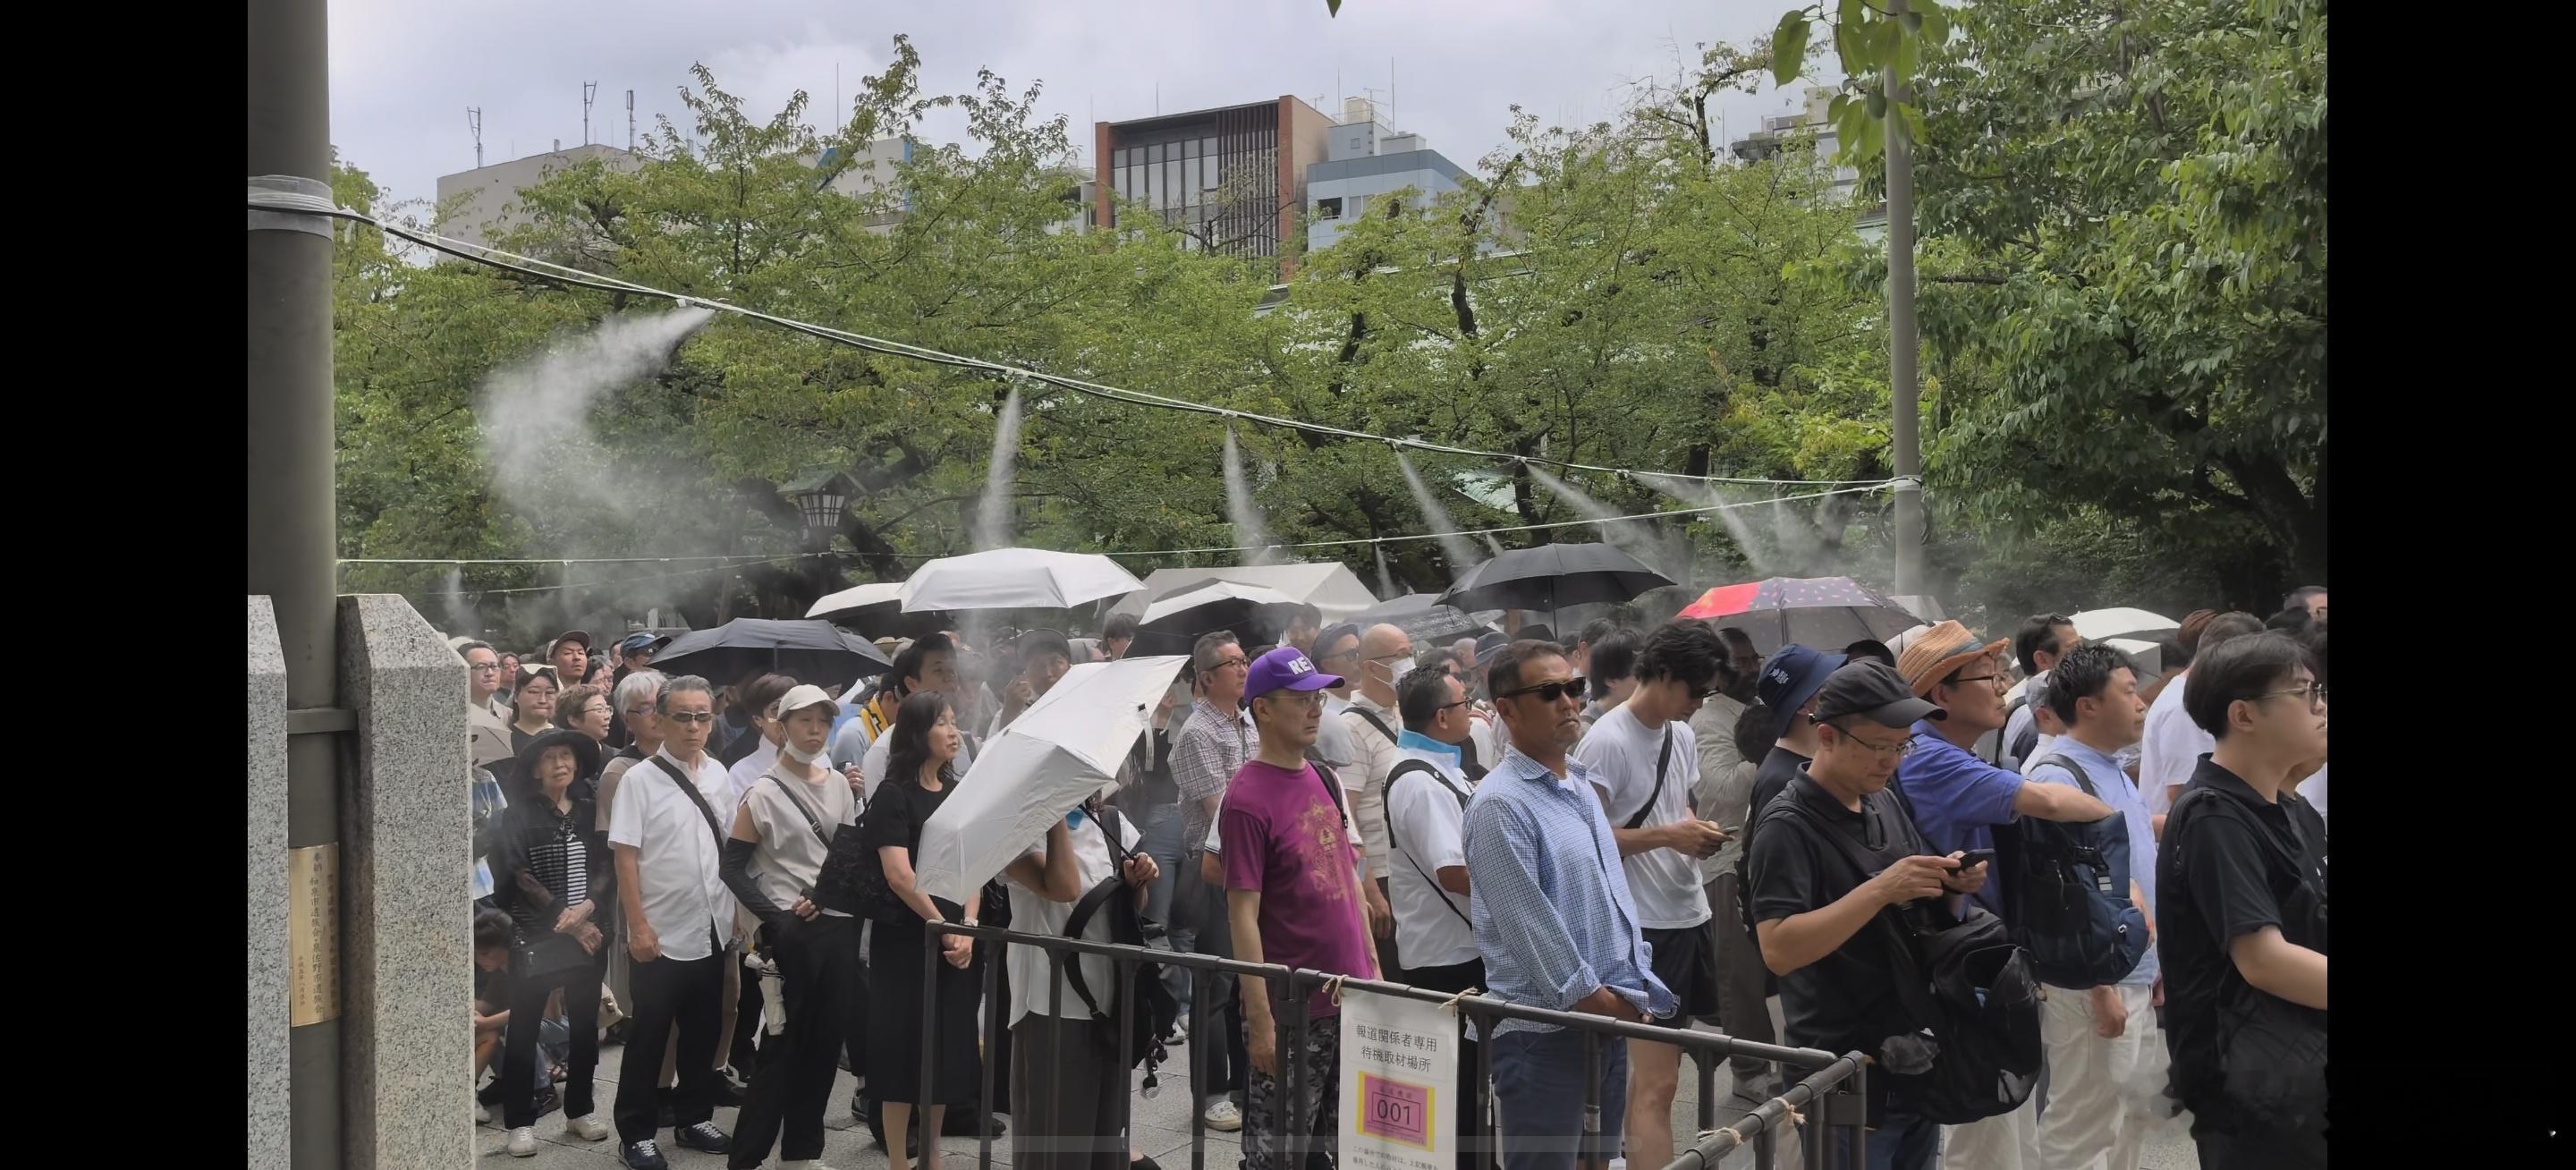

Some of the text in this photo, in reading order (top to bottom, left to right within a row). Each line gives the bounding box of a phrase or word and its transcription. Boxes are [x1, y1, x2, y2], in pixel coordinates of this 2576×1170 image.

[1356, 1024, 1437, 1053] 報道関係者専用
[1361, 1045, 1431, 1072] 待機取材場所
[1377, 1099, 1411, 1125] 001
